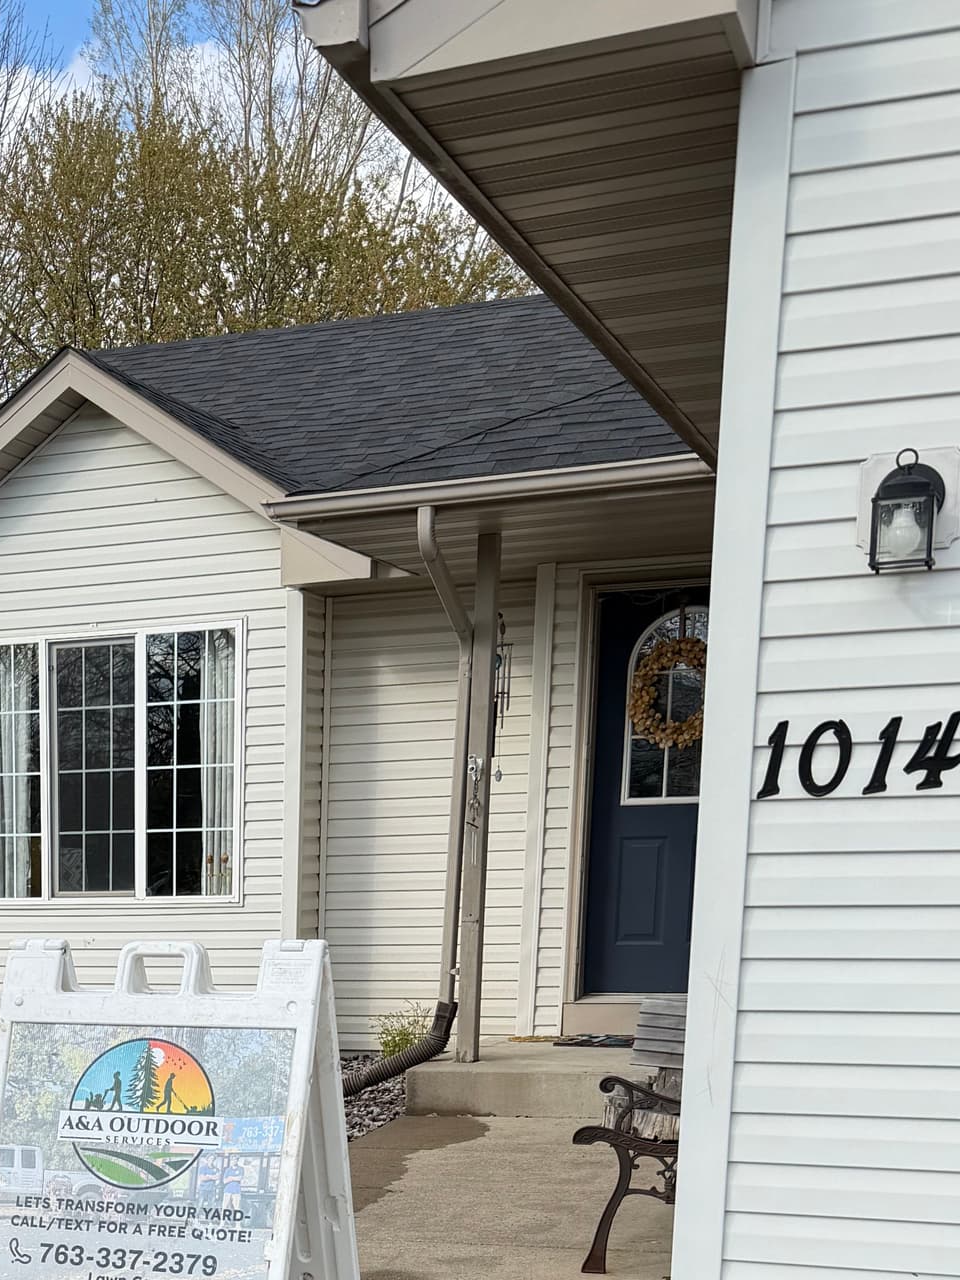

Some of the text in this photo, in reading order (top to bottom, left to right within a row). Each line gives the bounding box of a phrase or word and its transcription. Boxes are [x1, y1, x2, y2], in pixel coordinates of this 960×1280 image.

[756, 710, 960, 799] 1014
[61, 1115, 220, 1137] A&A OUTDOOR
[104, 1135, 171, 1145] SERVICES
[15, 1195, 251, 1222] LETS TRANSFORM YOUR YARD-
[10, 1215, 94, 1231] CALL/TEXT
[98, 1221, 128, 1234] FOR
[132, 1223, 143, 1235] A
[148, 1224, 187, 1238] FREE
[39, 1243, 218, 1276] 763-337-2379
